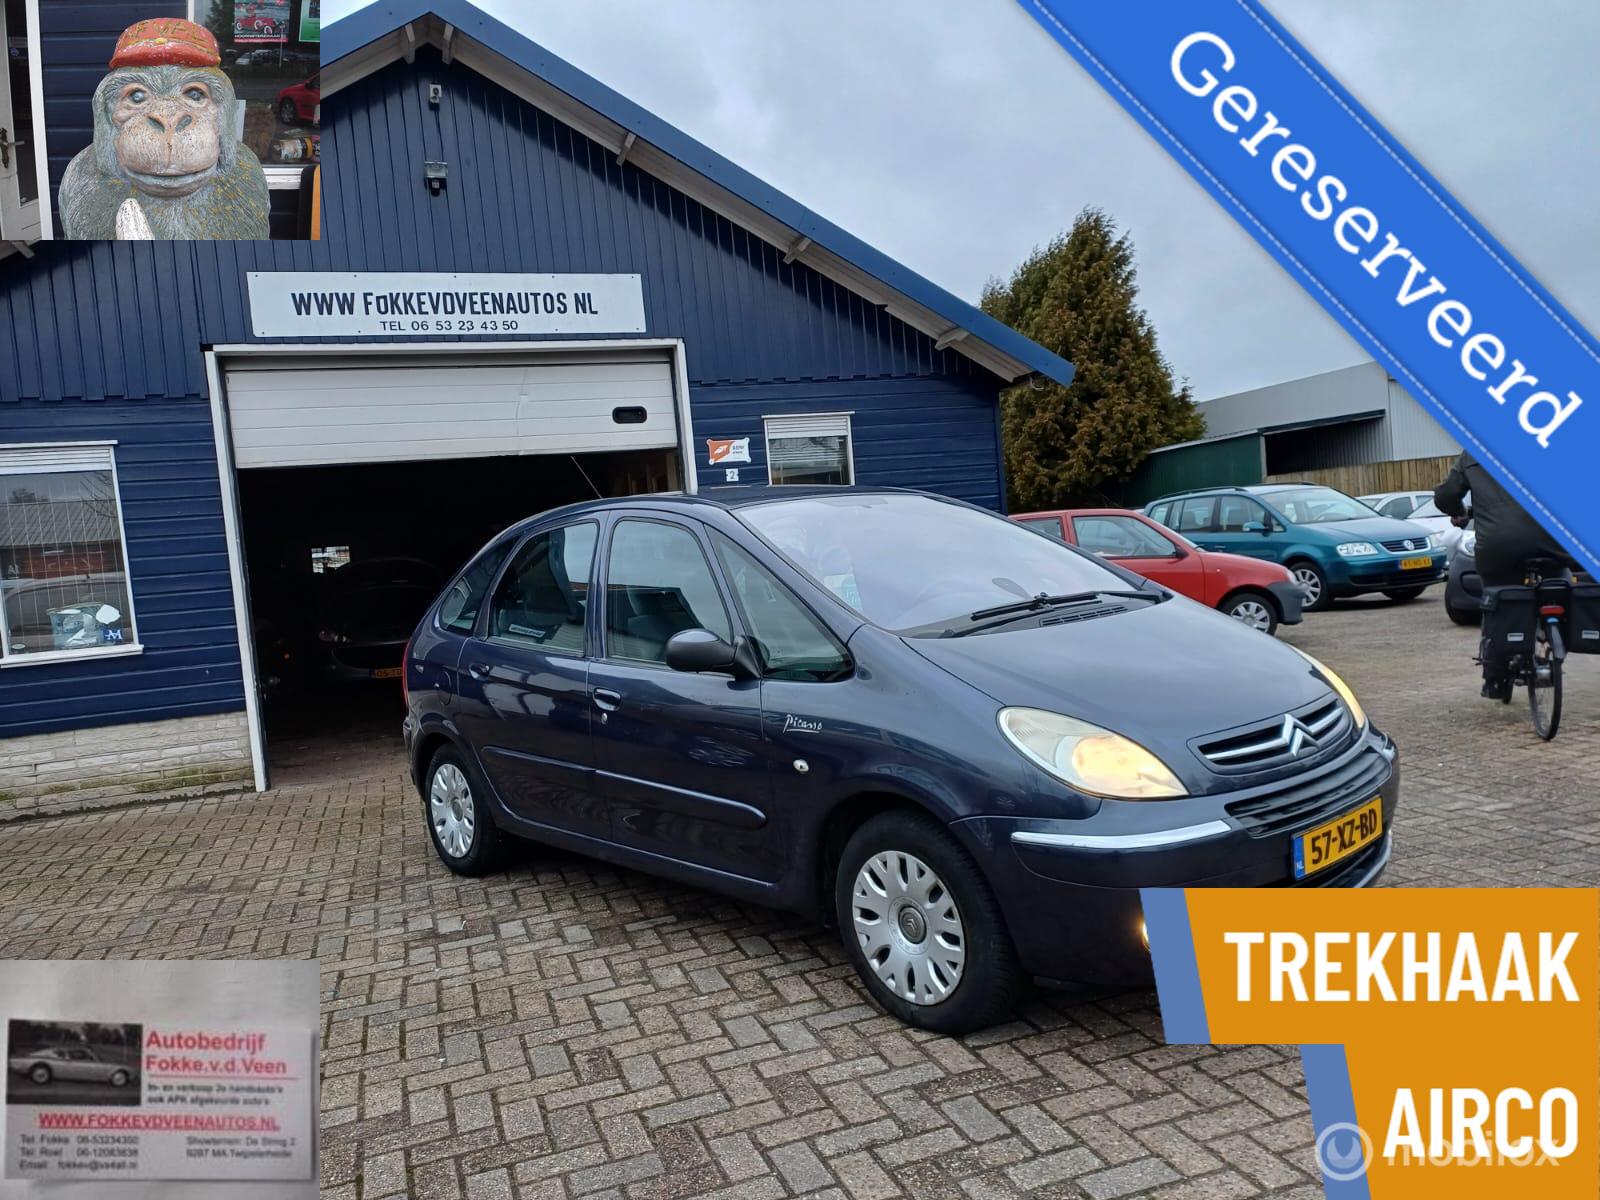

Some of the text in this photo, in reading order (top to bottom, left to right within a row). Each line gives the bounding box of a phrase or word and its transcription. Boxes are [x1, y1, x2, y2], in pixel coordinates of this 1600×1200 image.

[291, 292, 355, 316] WWW
[574, 292, 599, 315] NL
[380, 320, 519, 332] TEL 06 53 23 43 50
[783, 713, 823, 734] Picasso
[1311, 808, 1377, 865] 57-XZ-BD
[146, 1031, 267, 1054] Autobedrijf
